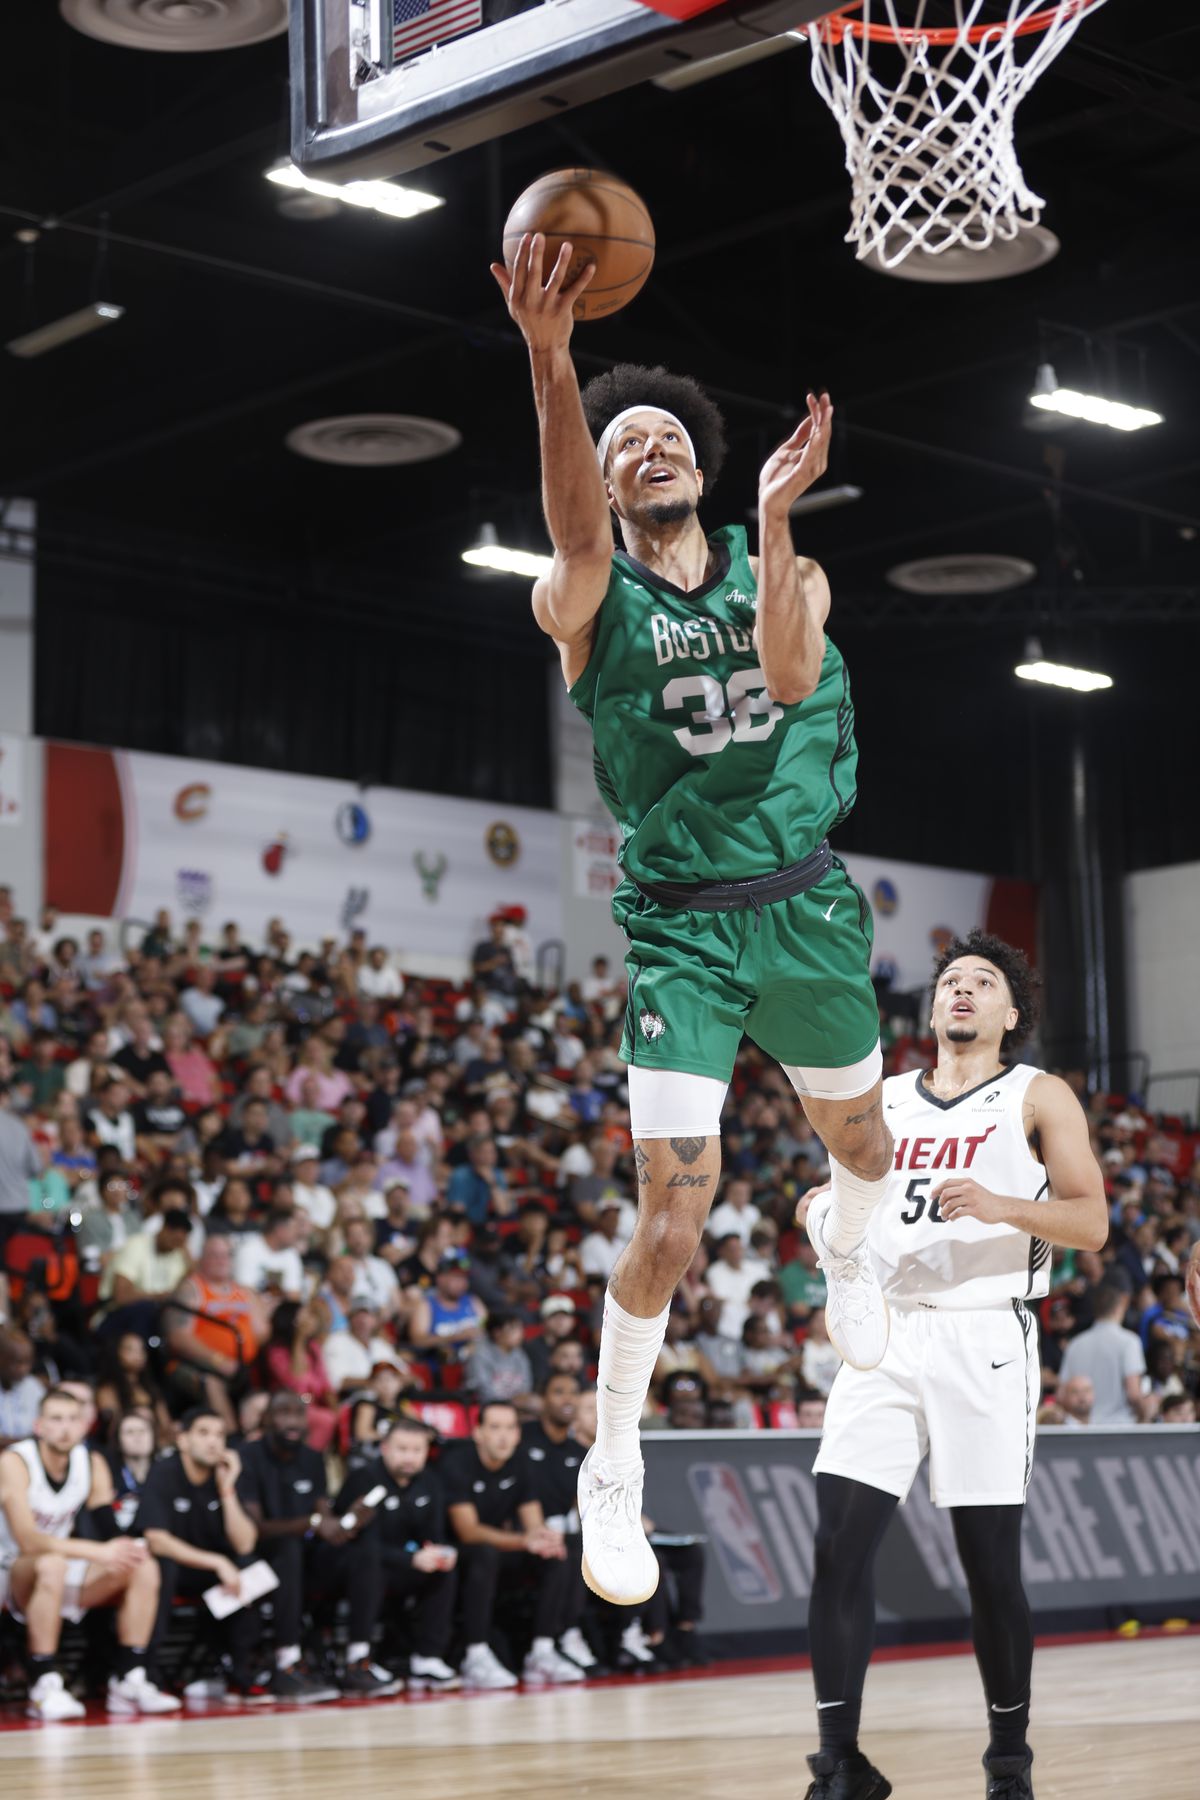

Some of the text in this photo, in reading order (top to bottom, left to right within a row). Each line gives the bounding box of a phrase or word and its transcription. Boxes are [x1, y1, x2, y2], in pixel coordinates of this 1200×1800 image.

[651, 613, 757, 666] BOSTO
[893, 1124, 997, 1171] HEAT
[666, 1173, 711, 1189] LOVE
[1093, 1456, 1200, 1577] FAN
